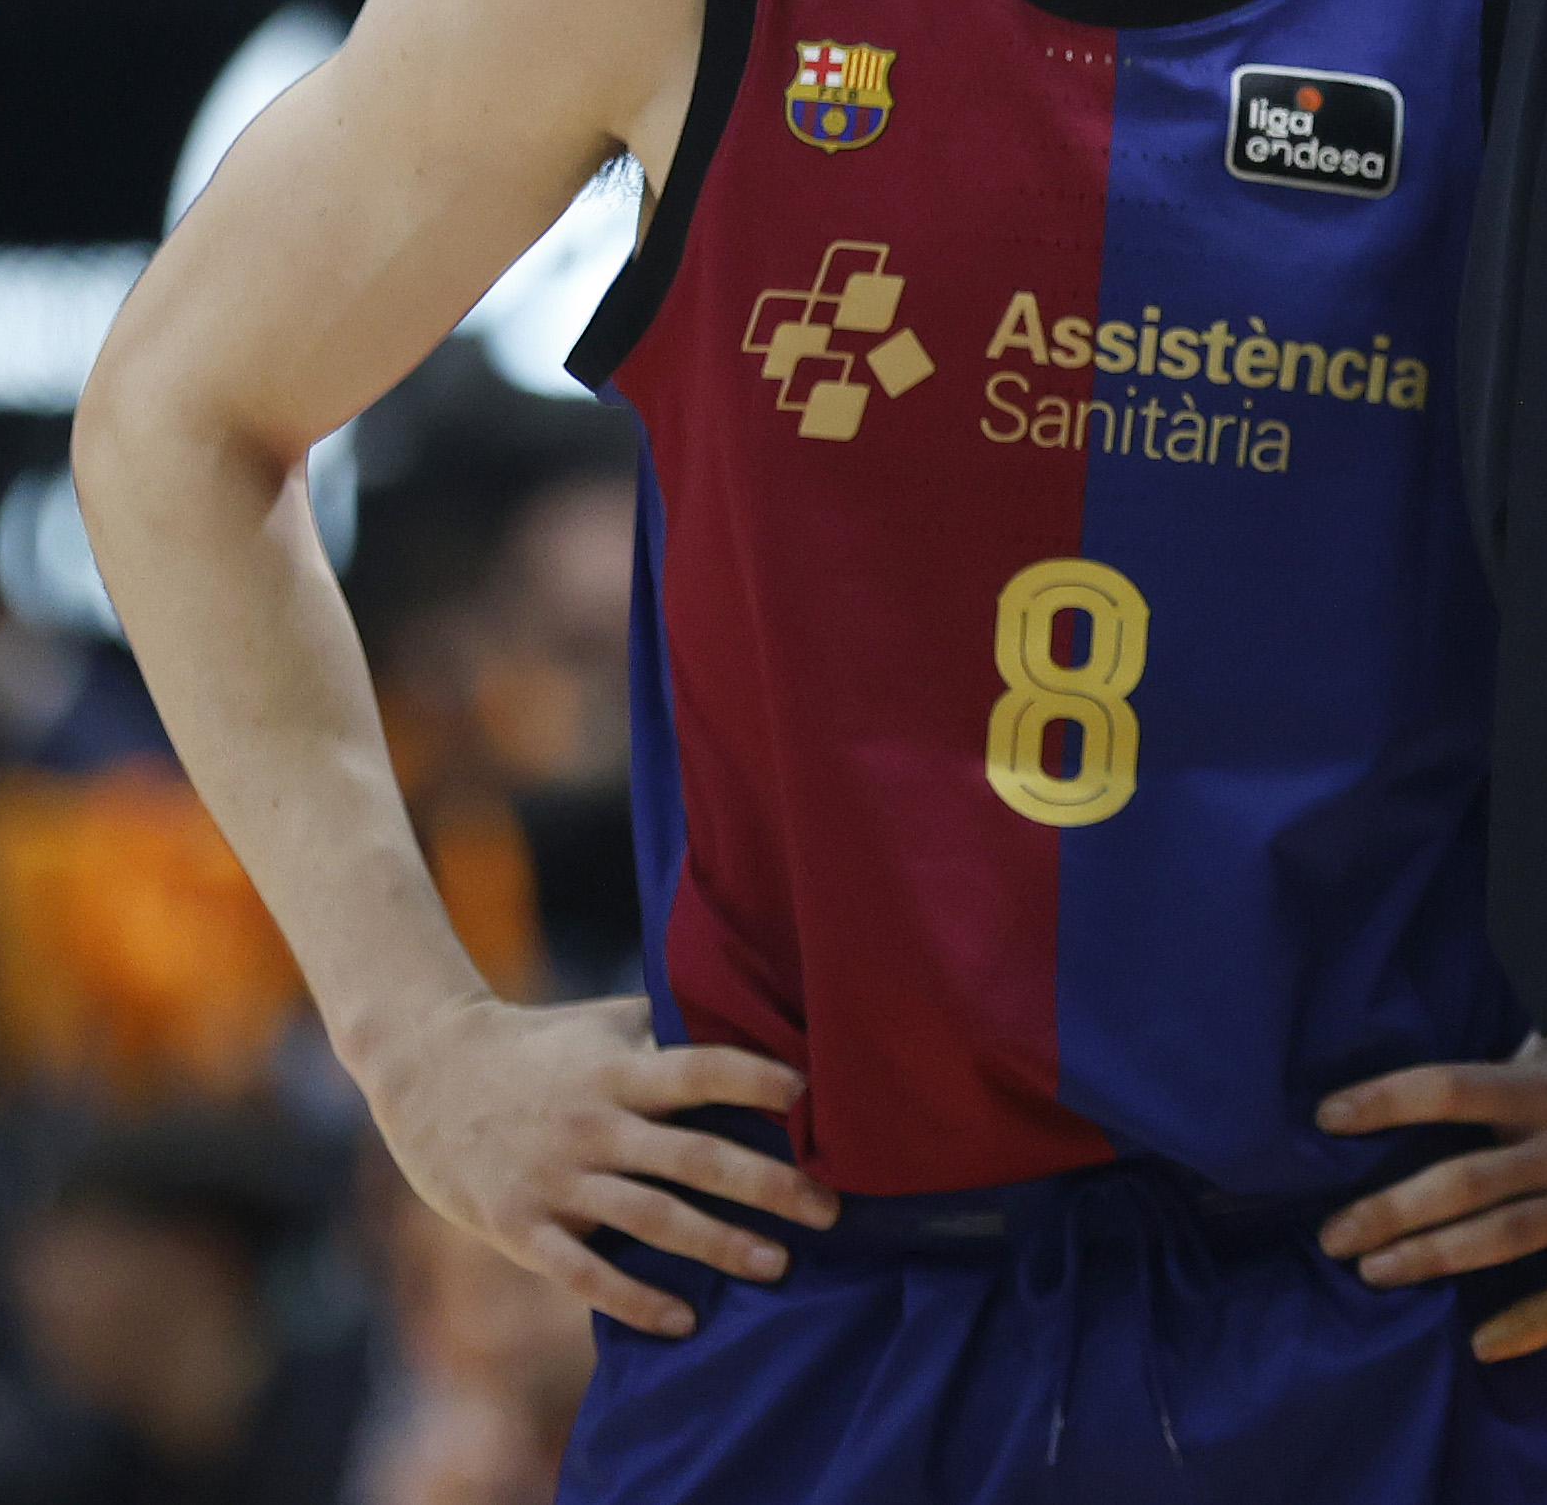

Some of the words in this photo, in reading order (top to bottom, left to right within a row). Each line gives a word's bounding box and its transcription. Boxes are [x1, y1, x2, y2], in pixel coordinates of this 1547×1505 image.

[1244, 135, 1386, 180] endesa
[1248, 97, 1315, 139] liga
[985, 290, 1429, 412] Assistència
[980, 371, 1292, 474] Sanitària
[985, 556, 1151, 828] 8
